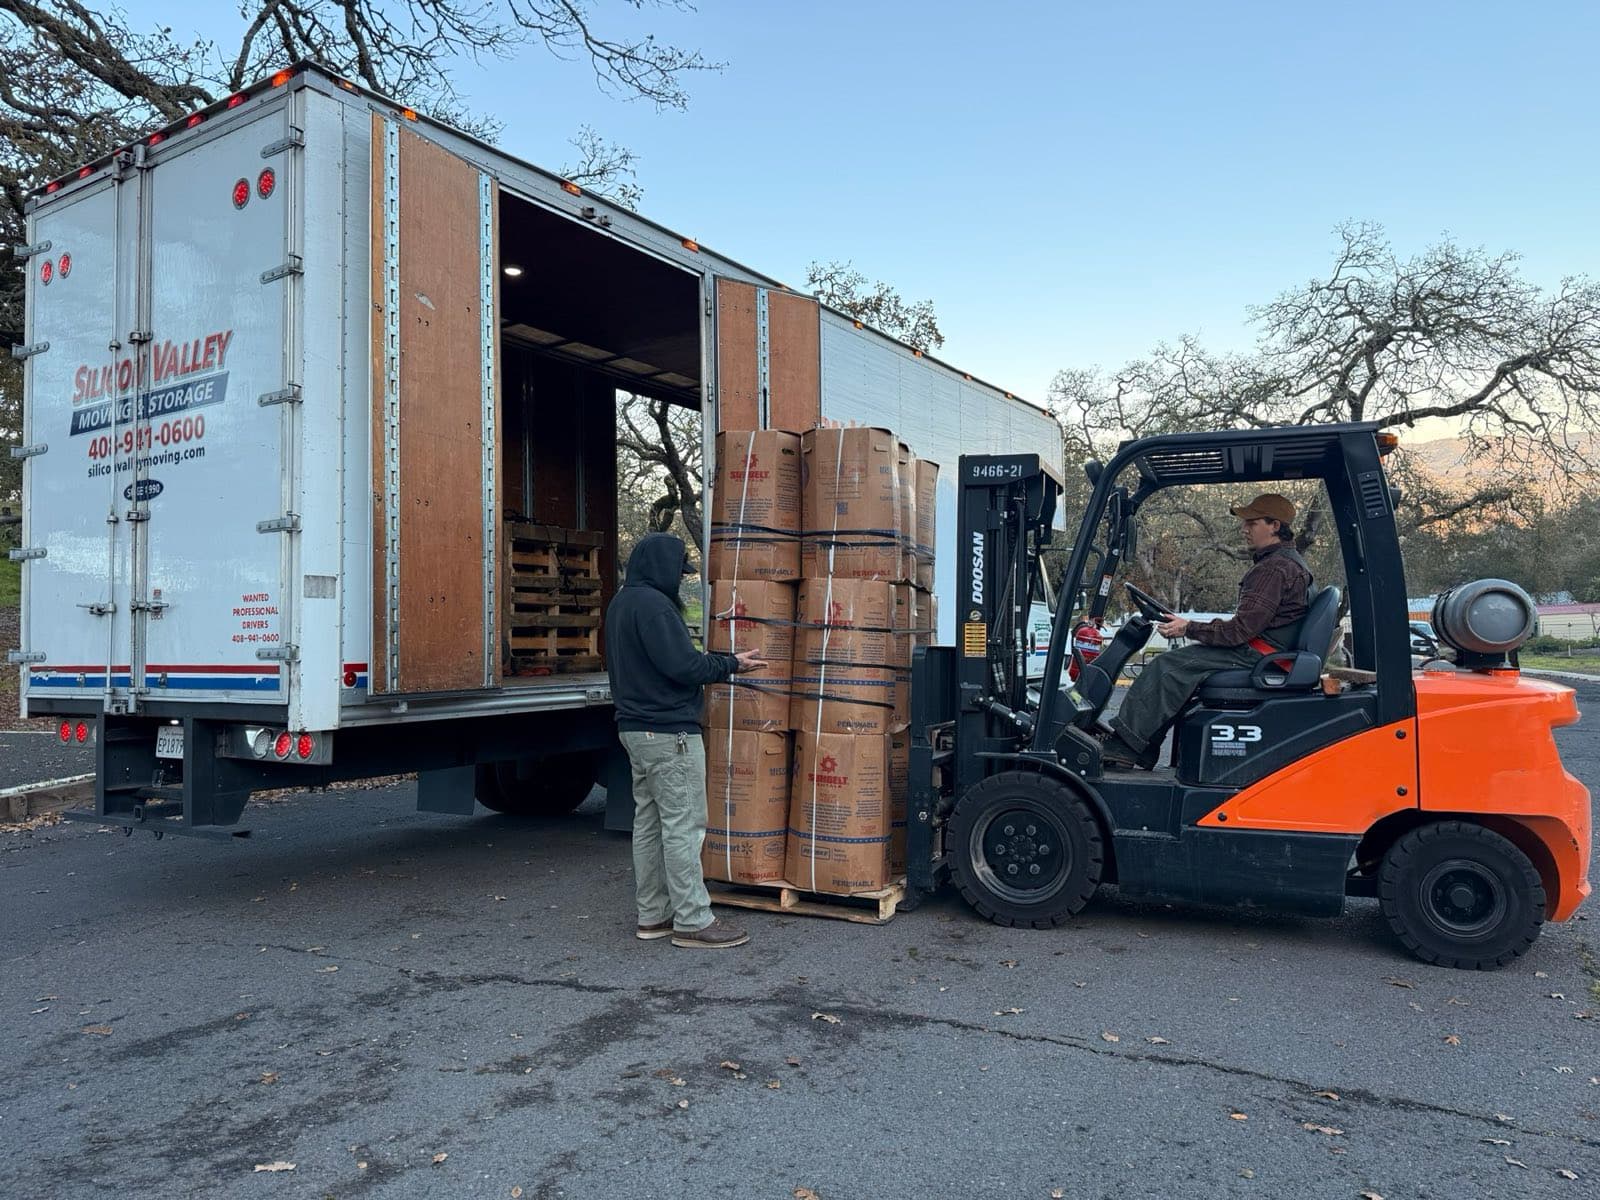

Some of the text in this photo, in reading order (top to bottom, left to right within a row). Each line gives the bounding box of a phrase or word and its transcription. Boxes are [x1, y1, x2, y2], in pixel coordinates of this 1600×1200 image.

[153, 330, 233, 382] VALLEY
[148, 381, 215, 414] STORAGE
[973, 464, 1022, 477] 9466-21
[972, 532, 984, 605] DOOSAN
[242, 593, 269, 602] WANTED
[232, 606, 279, 617] PROFESSIONAL
[242, 620, 269, 629] DRIVERS
[232, 633, 280, 643] 408-941-0600
[1211, 724, 1262, 742] 33
